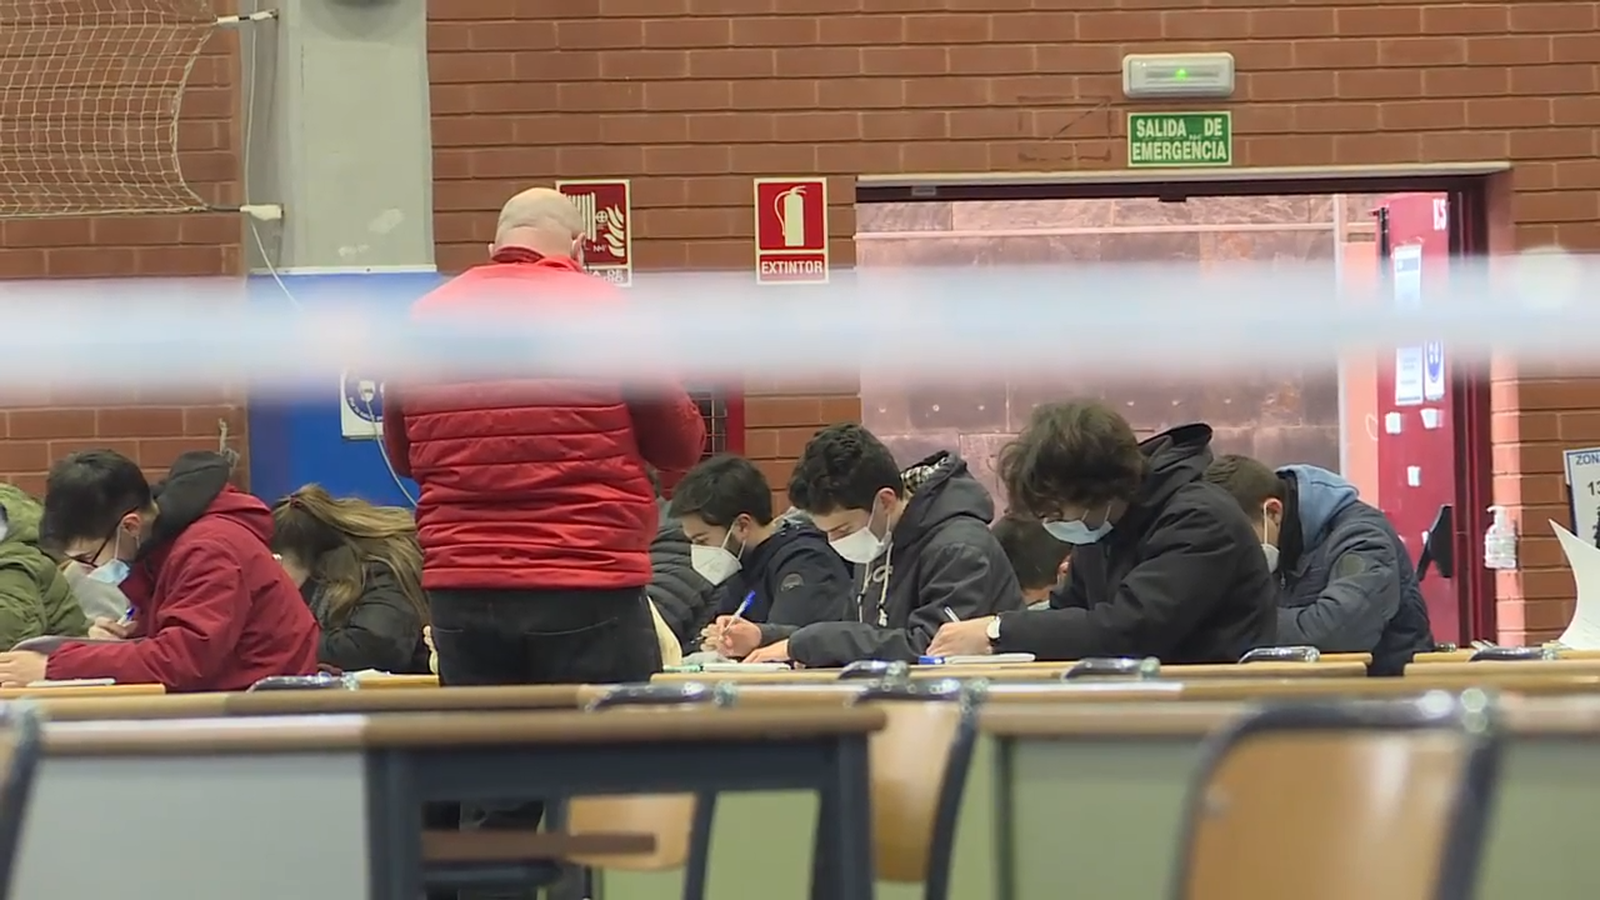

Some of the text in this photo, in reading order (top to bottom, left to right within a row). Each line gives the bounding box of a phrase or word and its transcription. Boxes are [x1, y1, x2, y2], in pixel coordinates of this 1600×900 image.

[1136, 117, 1223, 138] SALIDA DE
[1132, 141, 1227, 160] EMERGENCIA
[761, 260, 823, 274] EXTINTOR
[1575, 453, 1600, 466] ZON
